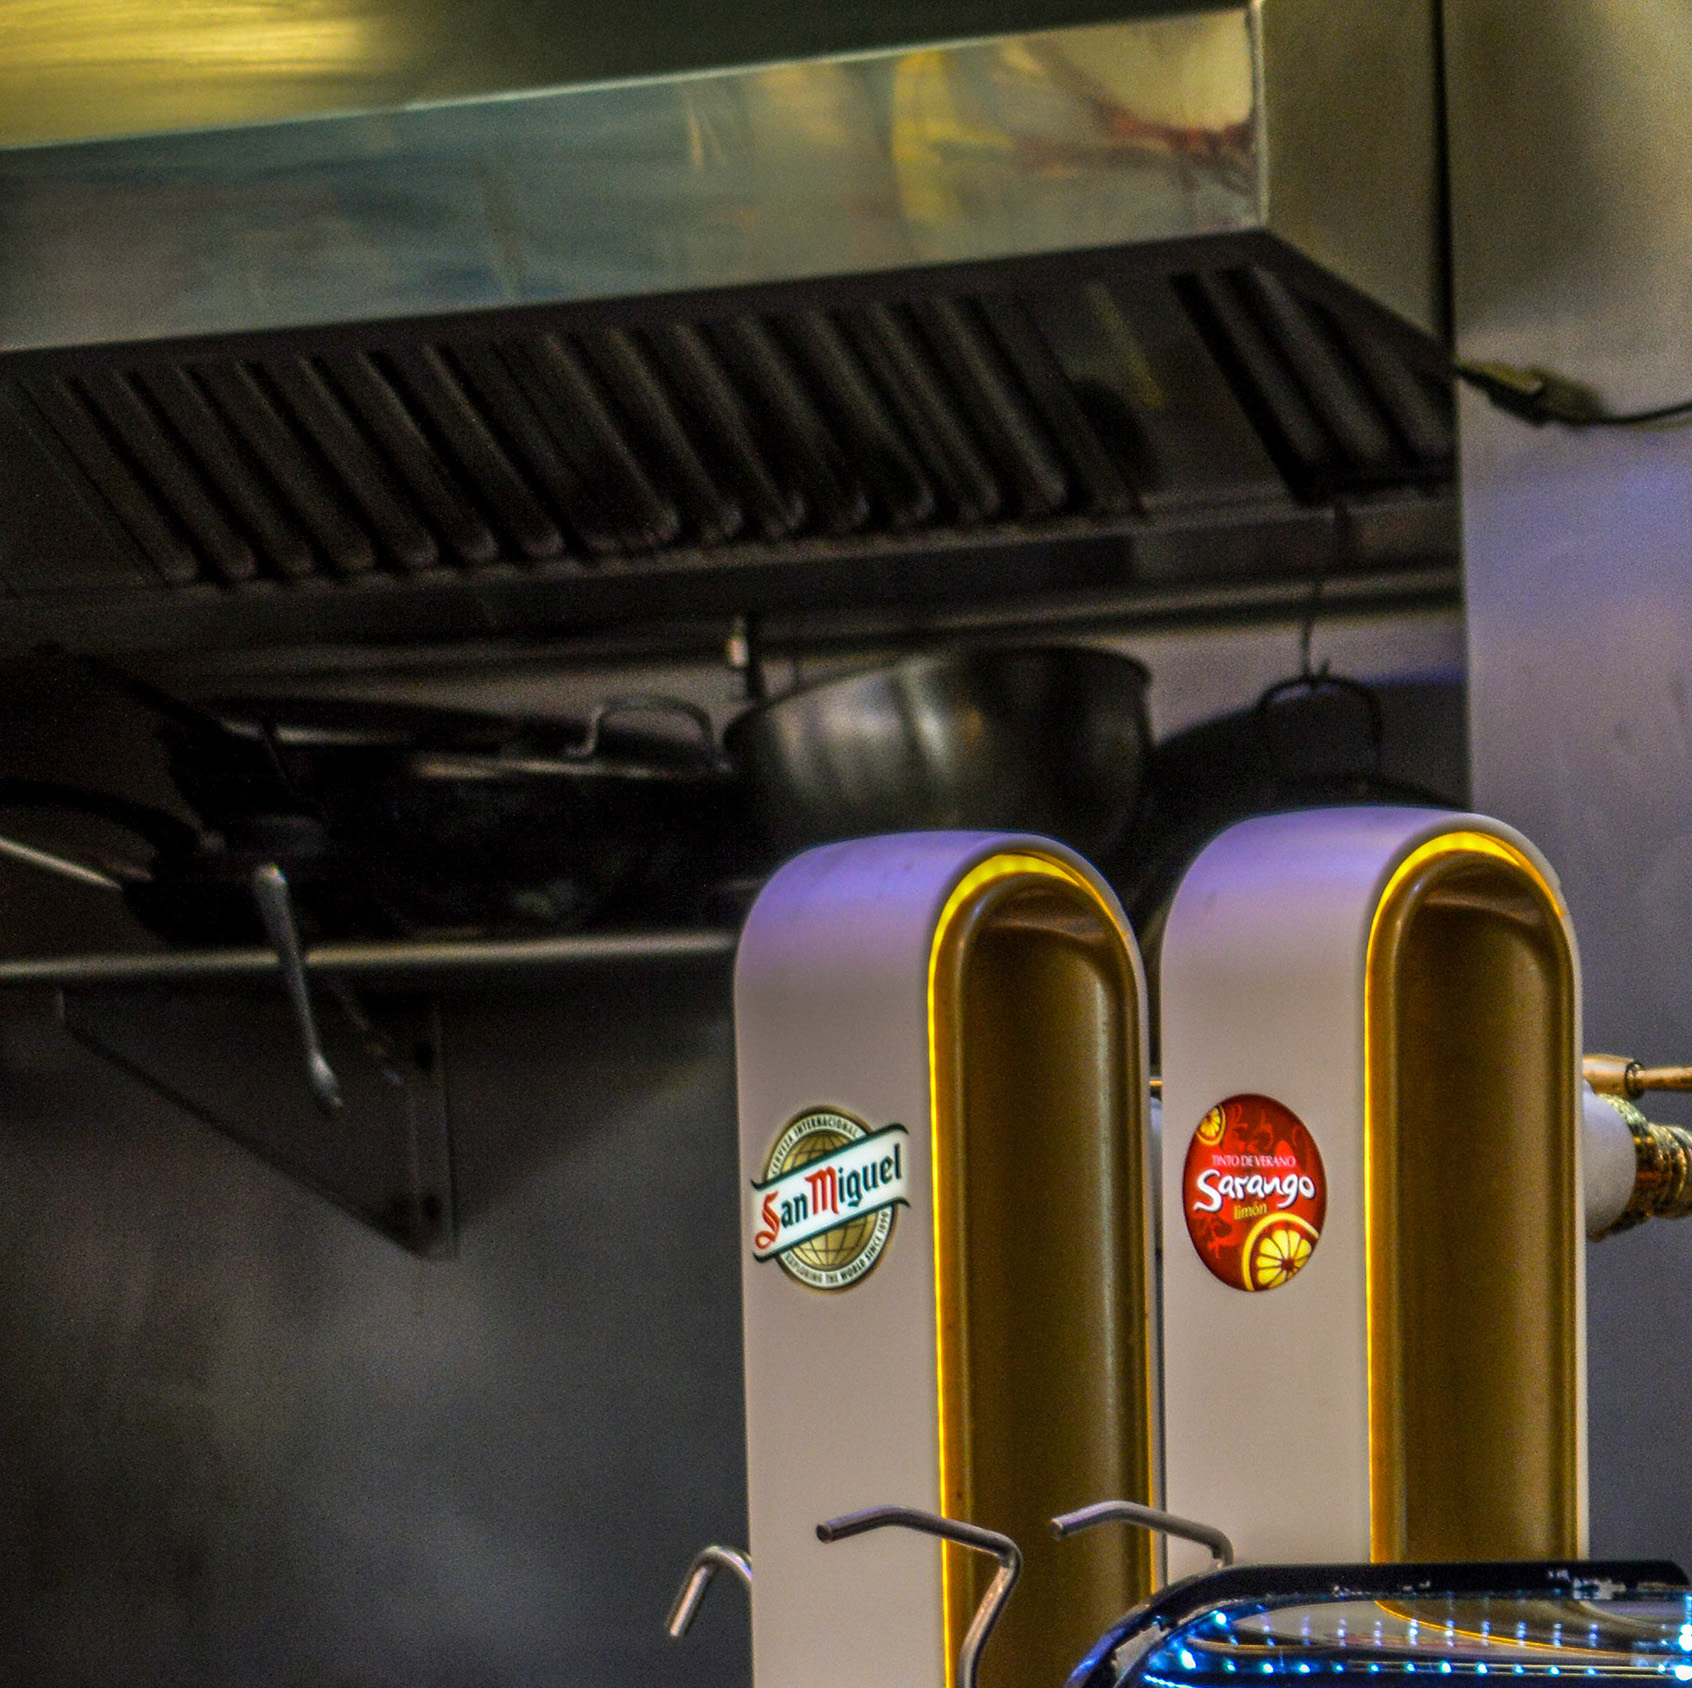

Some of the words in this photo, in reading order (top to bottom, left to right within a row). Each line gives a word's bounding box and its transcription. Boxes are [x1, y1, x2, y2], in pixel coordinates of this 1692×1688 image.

[1211, 1154, 1240, 1167] TINTO
[1253, 1154, 1297, 1167] VERANO
[1193, 1169, 1317, 1213] Sarango
[840, 1259, 867, 1281] WORLD
